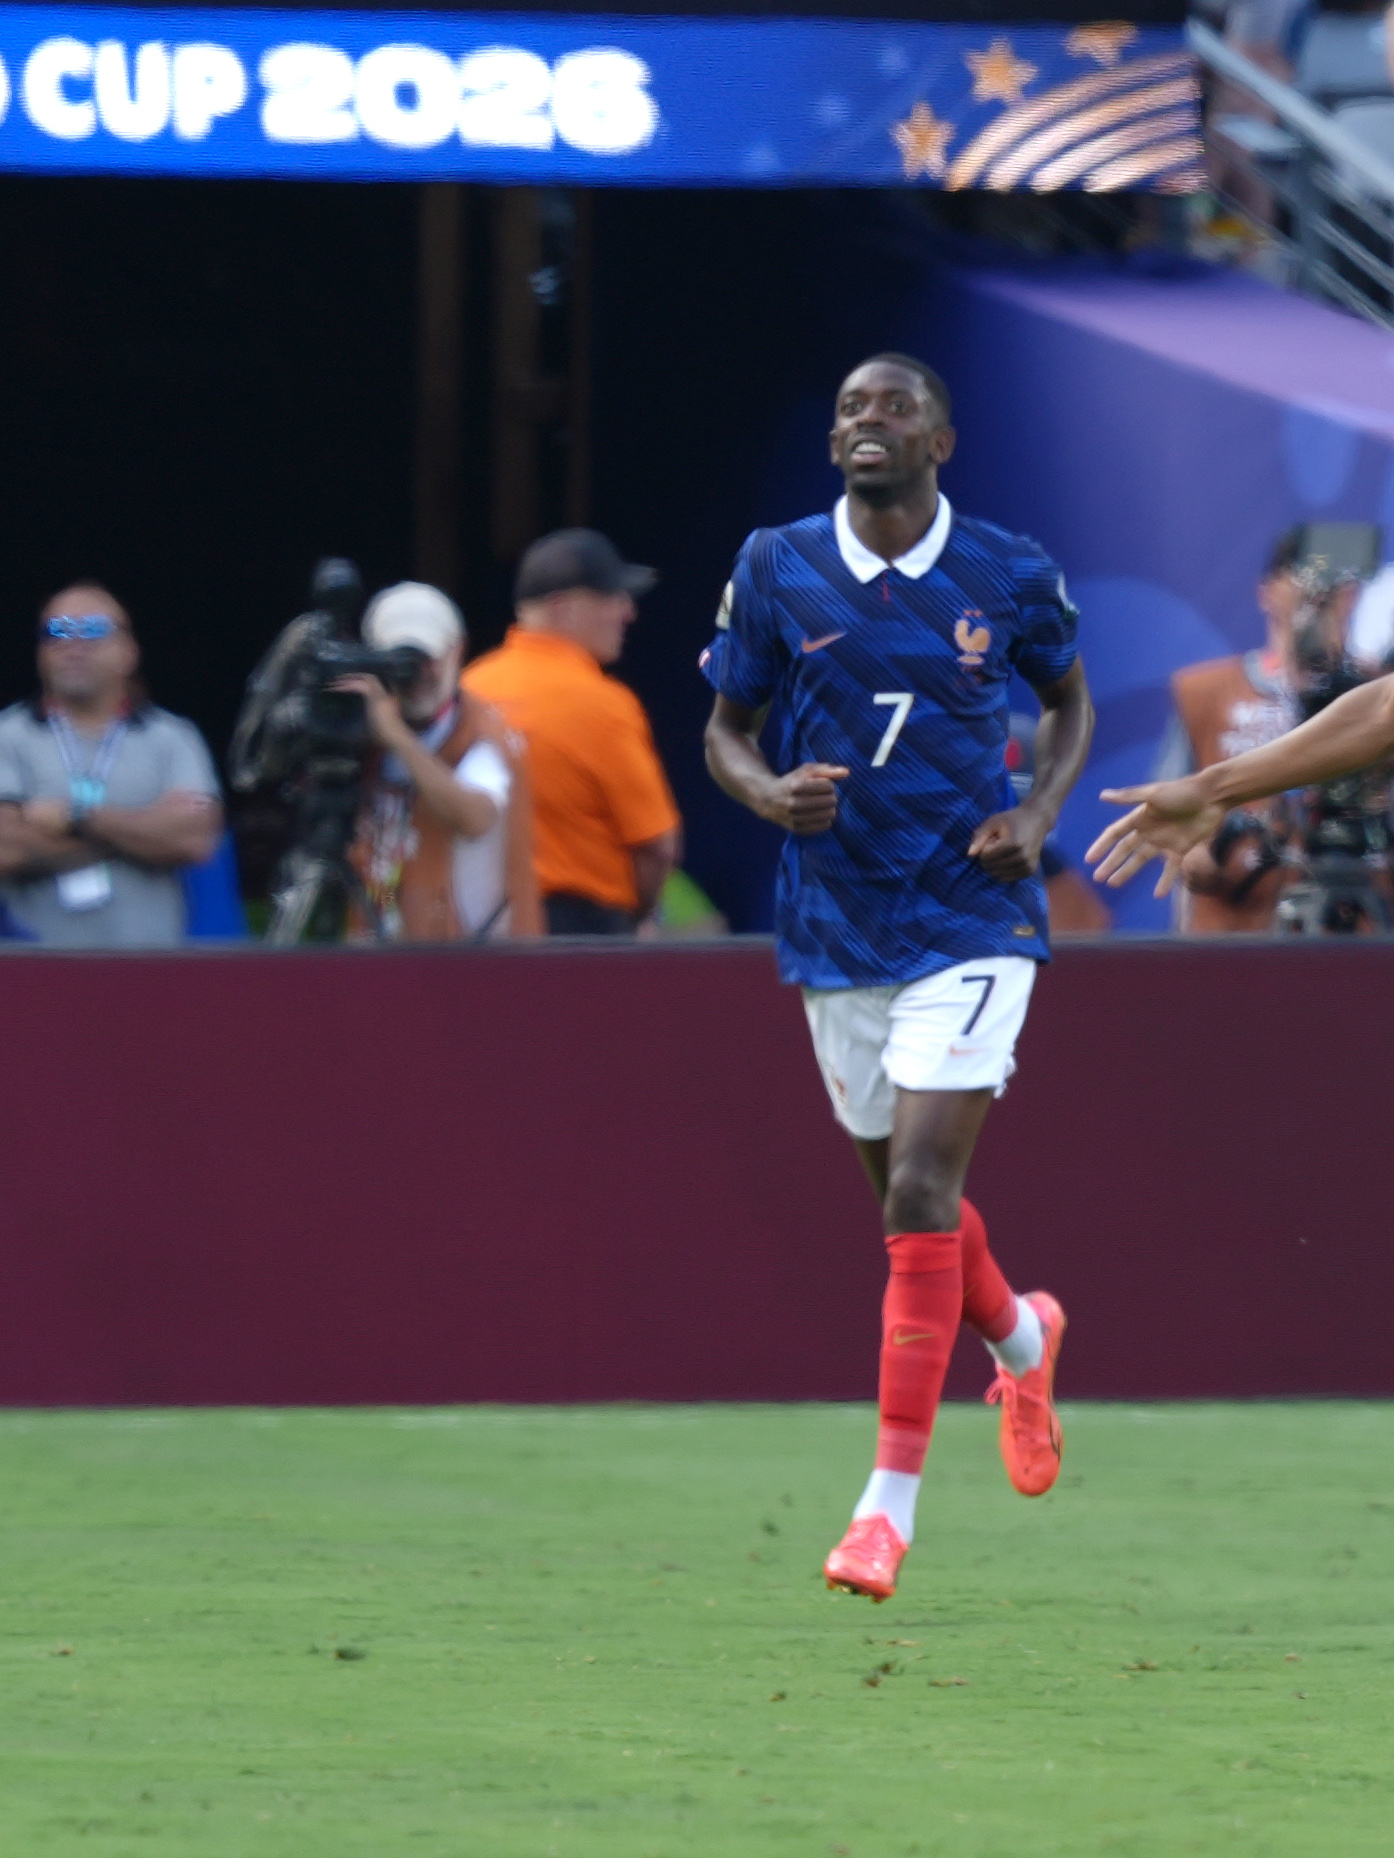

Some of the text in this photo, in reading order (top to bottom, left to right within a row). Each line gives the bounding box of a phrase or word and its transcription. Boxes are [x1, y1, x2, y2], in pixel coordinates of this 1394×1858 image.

[20, 36, 248, 142] CUP
[258, 42, 661, 156] 2026
[871, 692, 914, 768] 7
[961, 974, 995, 1036] 7
